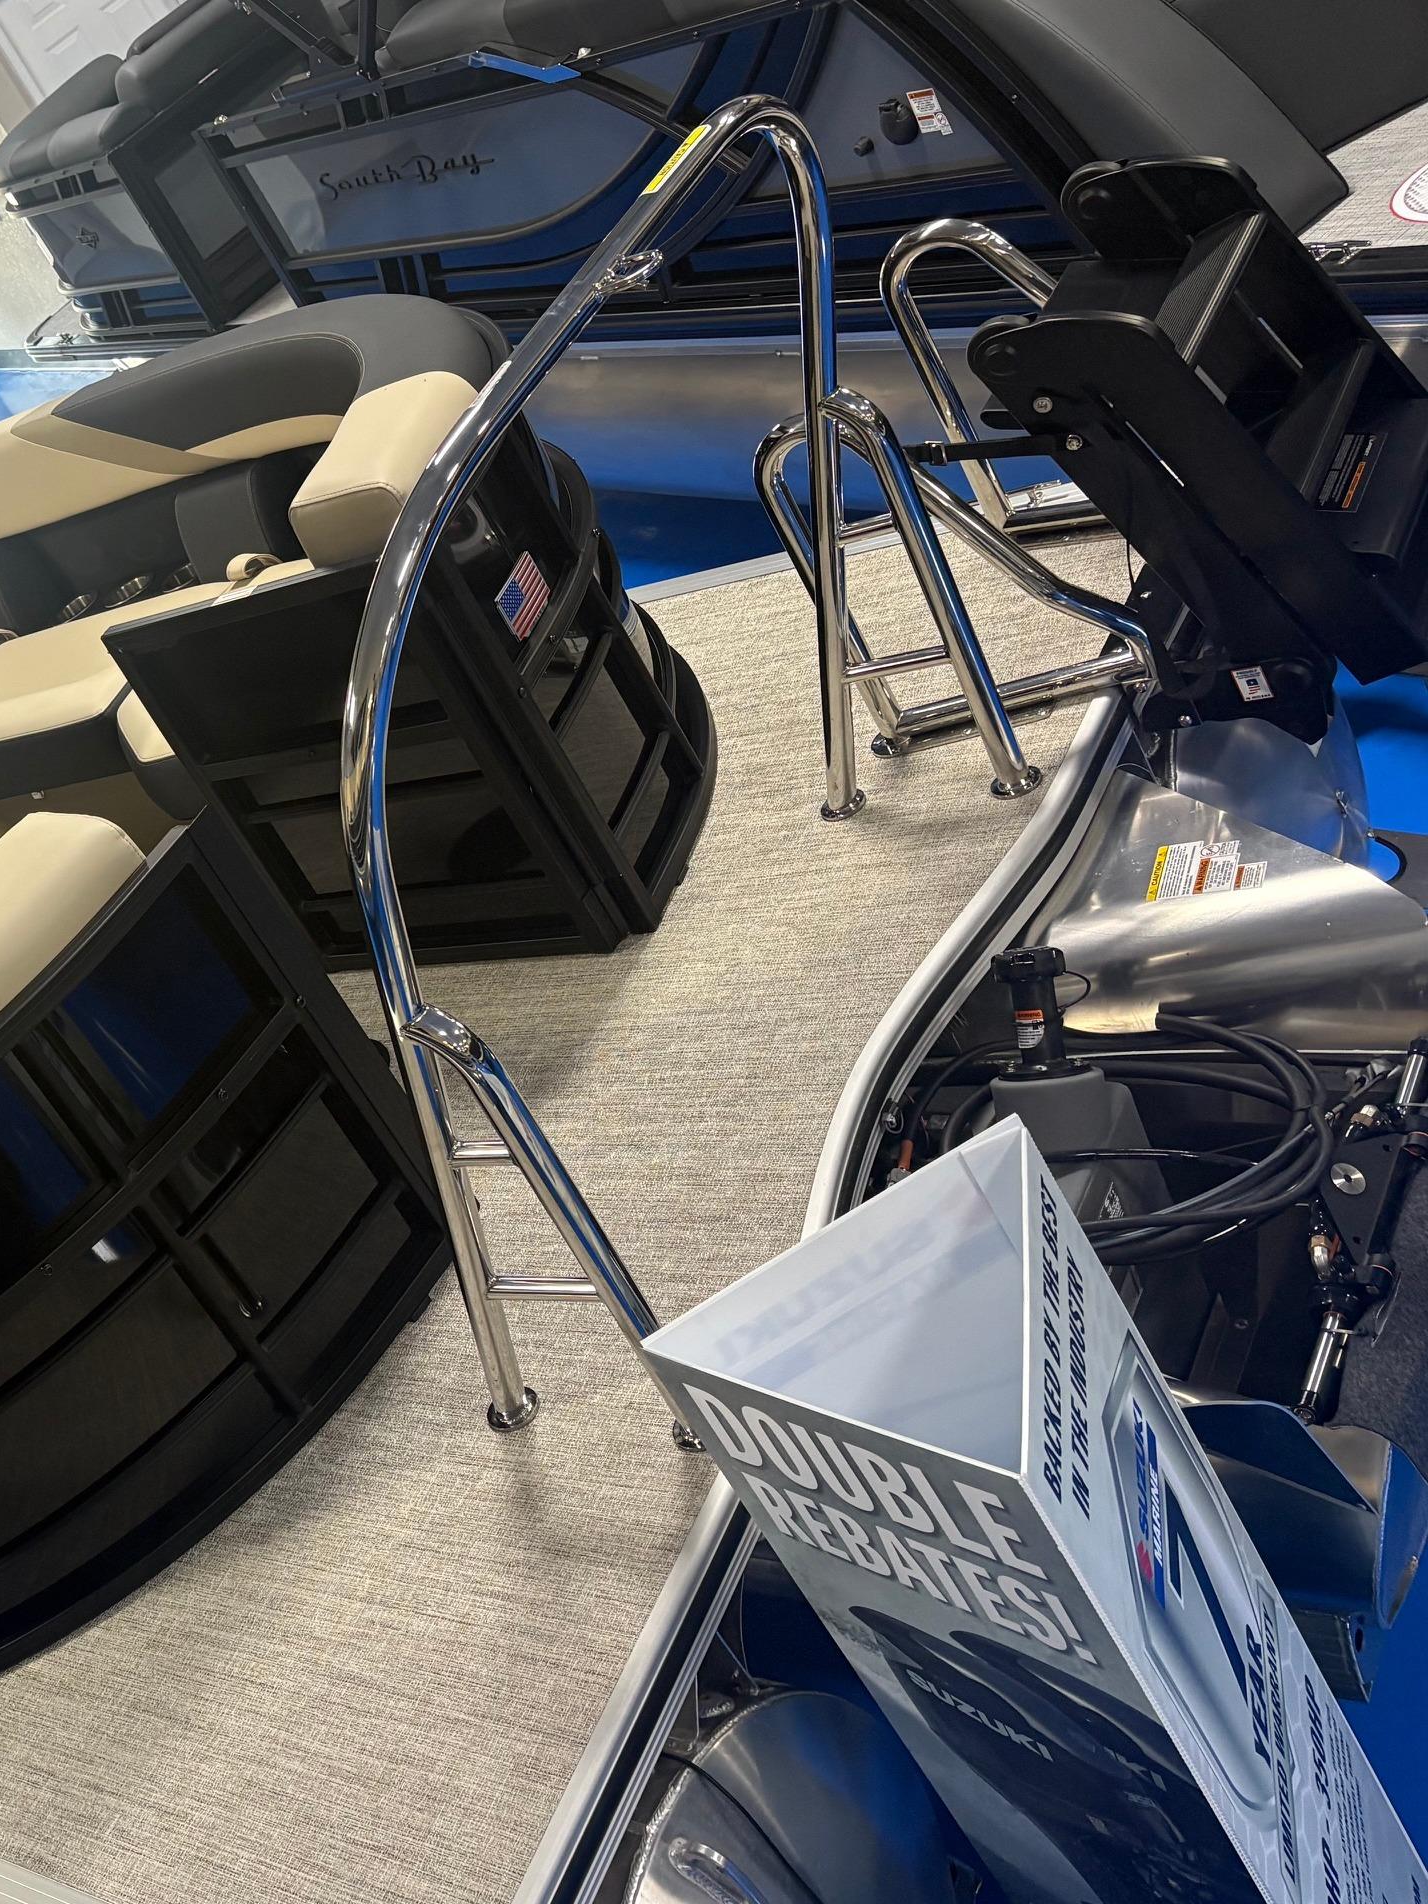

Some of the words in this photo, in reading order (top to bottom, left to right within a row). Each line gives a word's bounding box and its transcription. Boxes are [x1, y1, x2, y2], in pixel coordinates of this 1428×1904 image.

[319, 163, 403, 201] South
[400, 154, 495, 185] Bay
[1152, 861, 1162, 886] CAUTION
[1040, 1174, 1059, 1262] BEST
[1042, 1246, 1060, 1319] THE
[1043, 1305, 1061, 1369] BY
[1066, 1246, 1088, 1409] INDUSTRY
[682, 1383, 1048, 1582] DOUBLE
[1043, 1356, 1062, 1505] BACKED
[1071, 1404, 1089, 1473] THE
[1132, 1397, 1150, 1541] SUZUKI
[1072, 1472, 1090, 1521] IN
[1149, 1462, 1164, 1568] MARINE
[742, 1471, 1099, 1665] REBATES!
[1164, 1476, 1250, 1709] 7
[1246, 1624, 1272, 1770] YEAR
[905, 1668, 1054, 1763] SUZUKI
[1262, 1602, 1286, 1759] WARRANTY
[1304, 1674, 1332, 1811] 350HP
[1277, 1759, 1296, 1885] LIMITED
